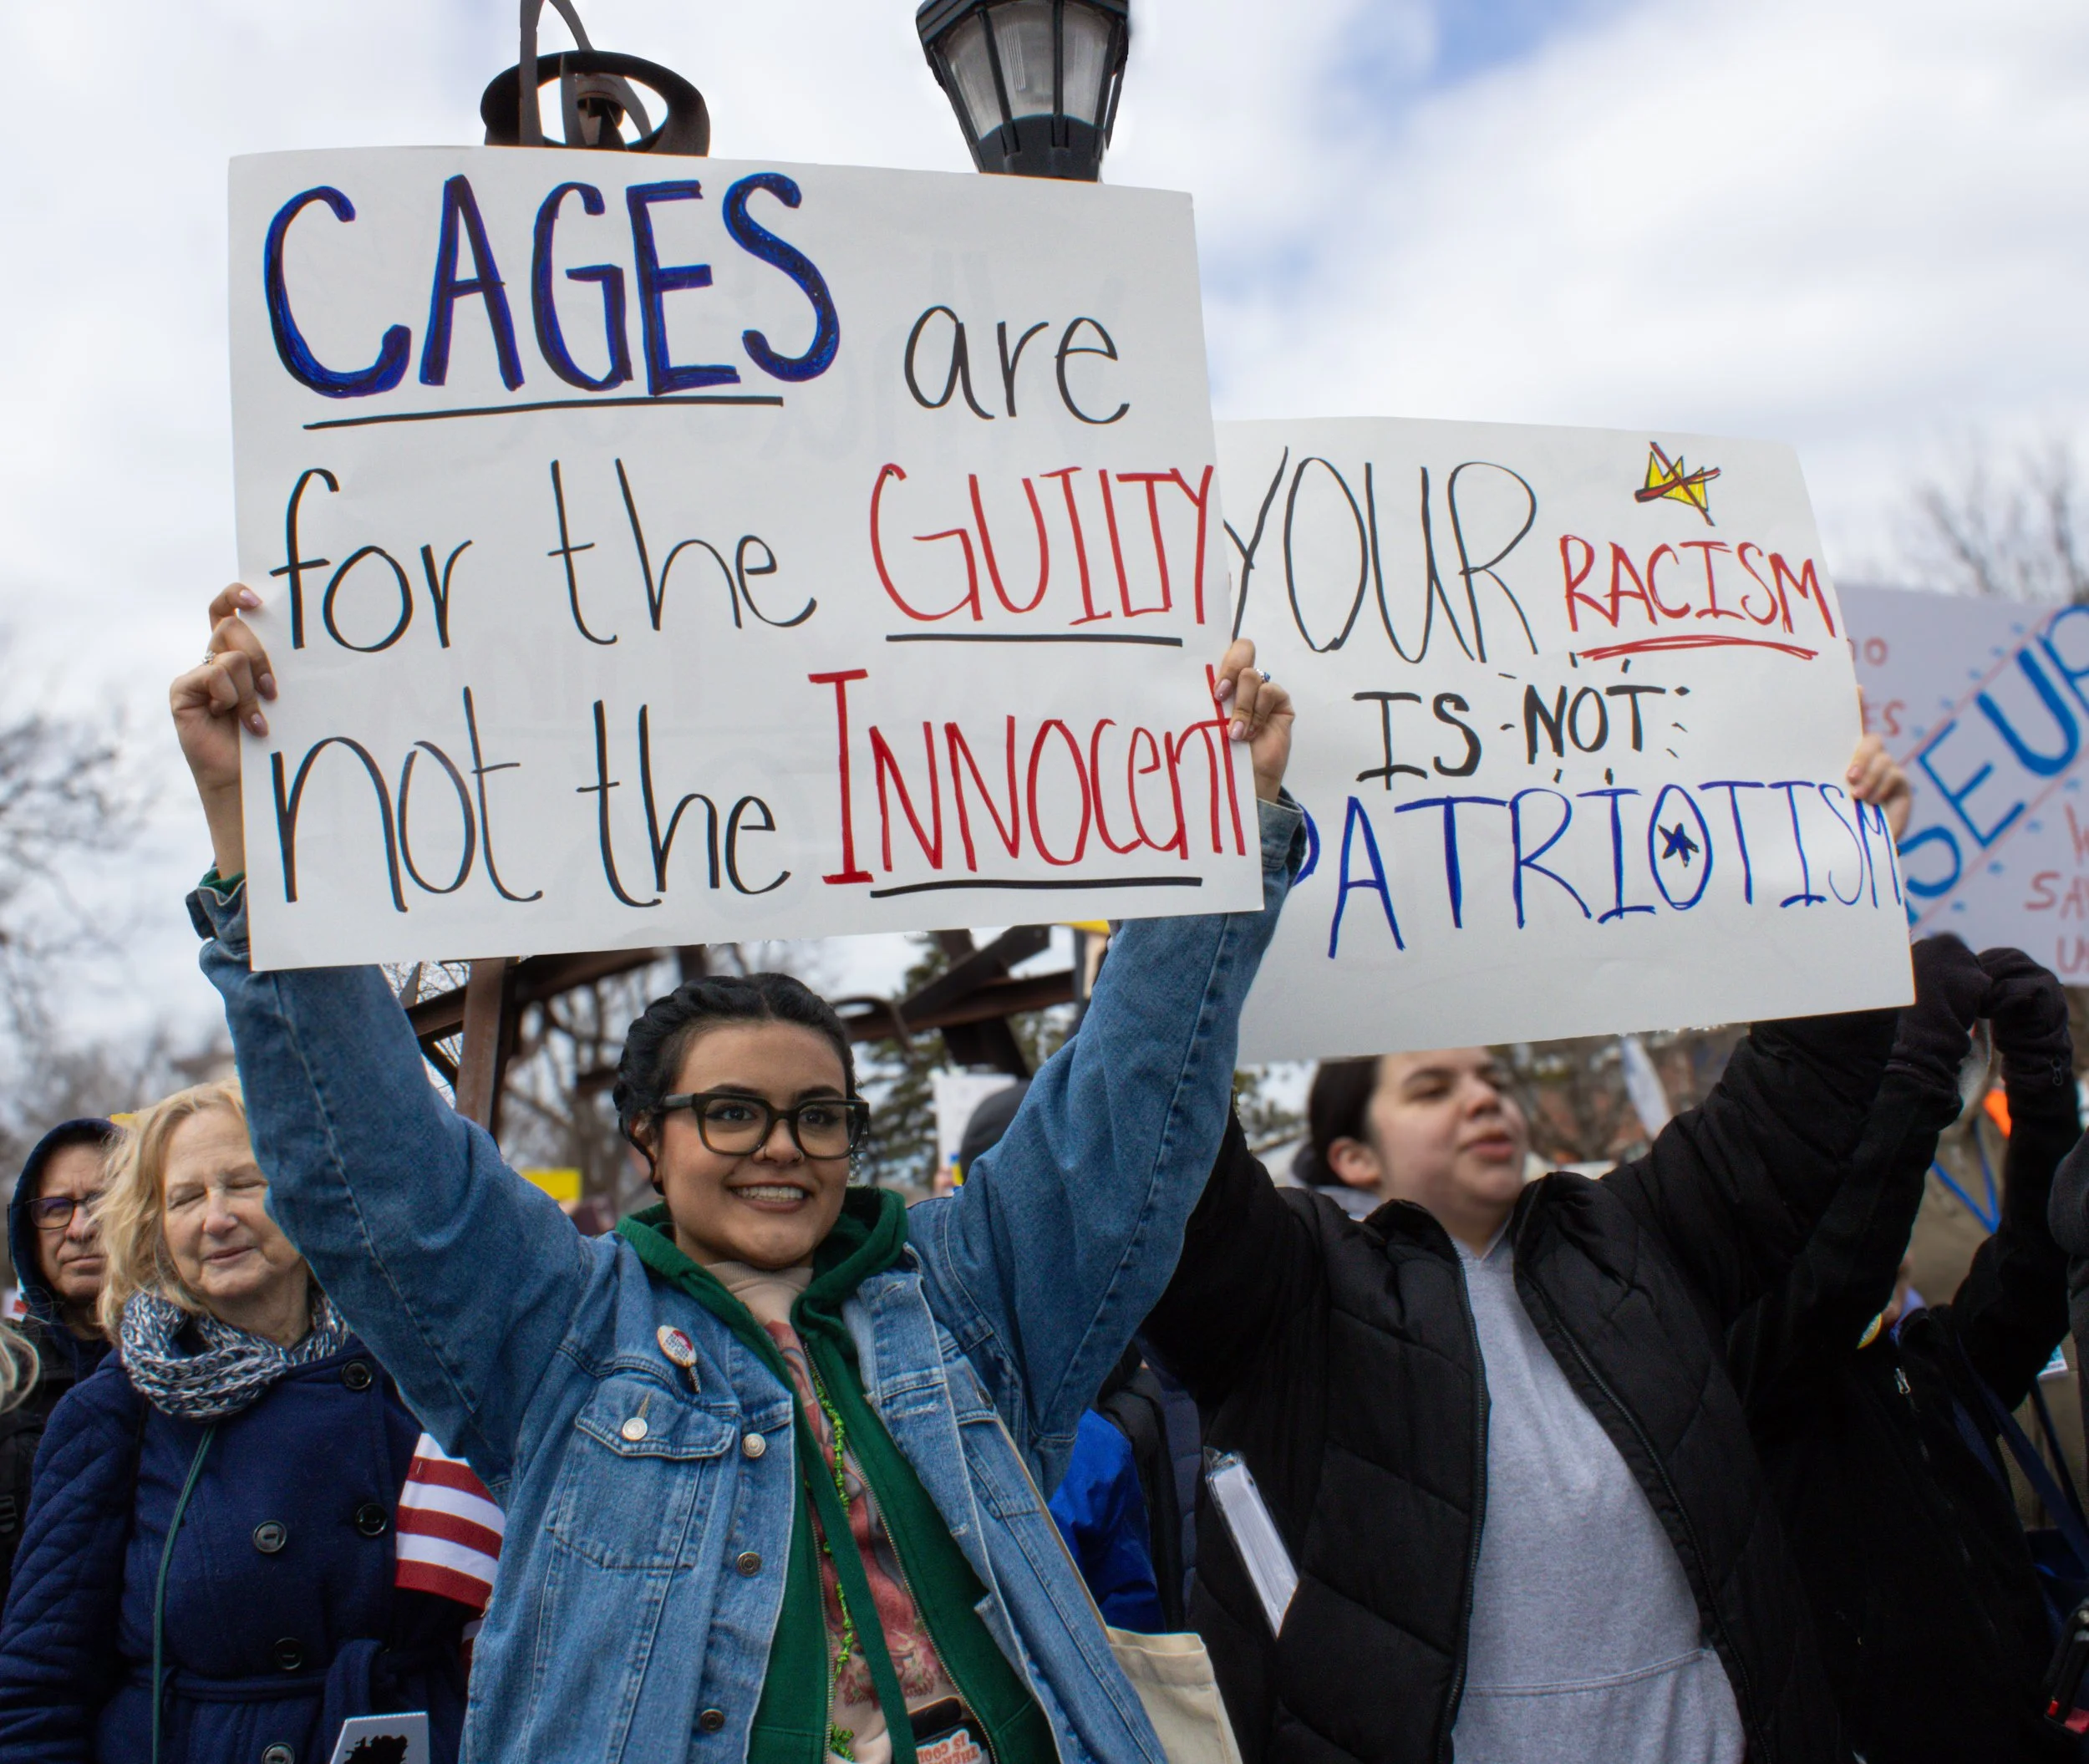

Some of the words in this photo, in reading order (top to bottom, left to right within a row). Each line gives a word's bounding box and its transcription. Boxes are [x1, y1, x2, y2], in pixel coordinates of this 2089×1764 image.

[263, 173, 841, 399] CAGES
[904, 305, 1130, 424] are
[269, 468, 473, 653] for
[547, 458, 817, 646] the
[870, 463, 1213, 625] GUILTY
[1224, 446, 1538, 663] YOUR
[1559, 526, 1836, 638] RACISM
[271, 686, 543, 913] not
[576, 699, 791, 907] the
[1352, 691, 1482, 790] IS
[1523, 684, 1666, 765] NOT
[2056, 934, 2089, 974] U
